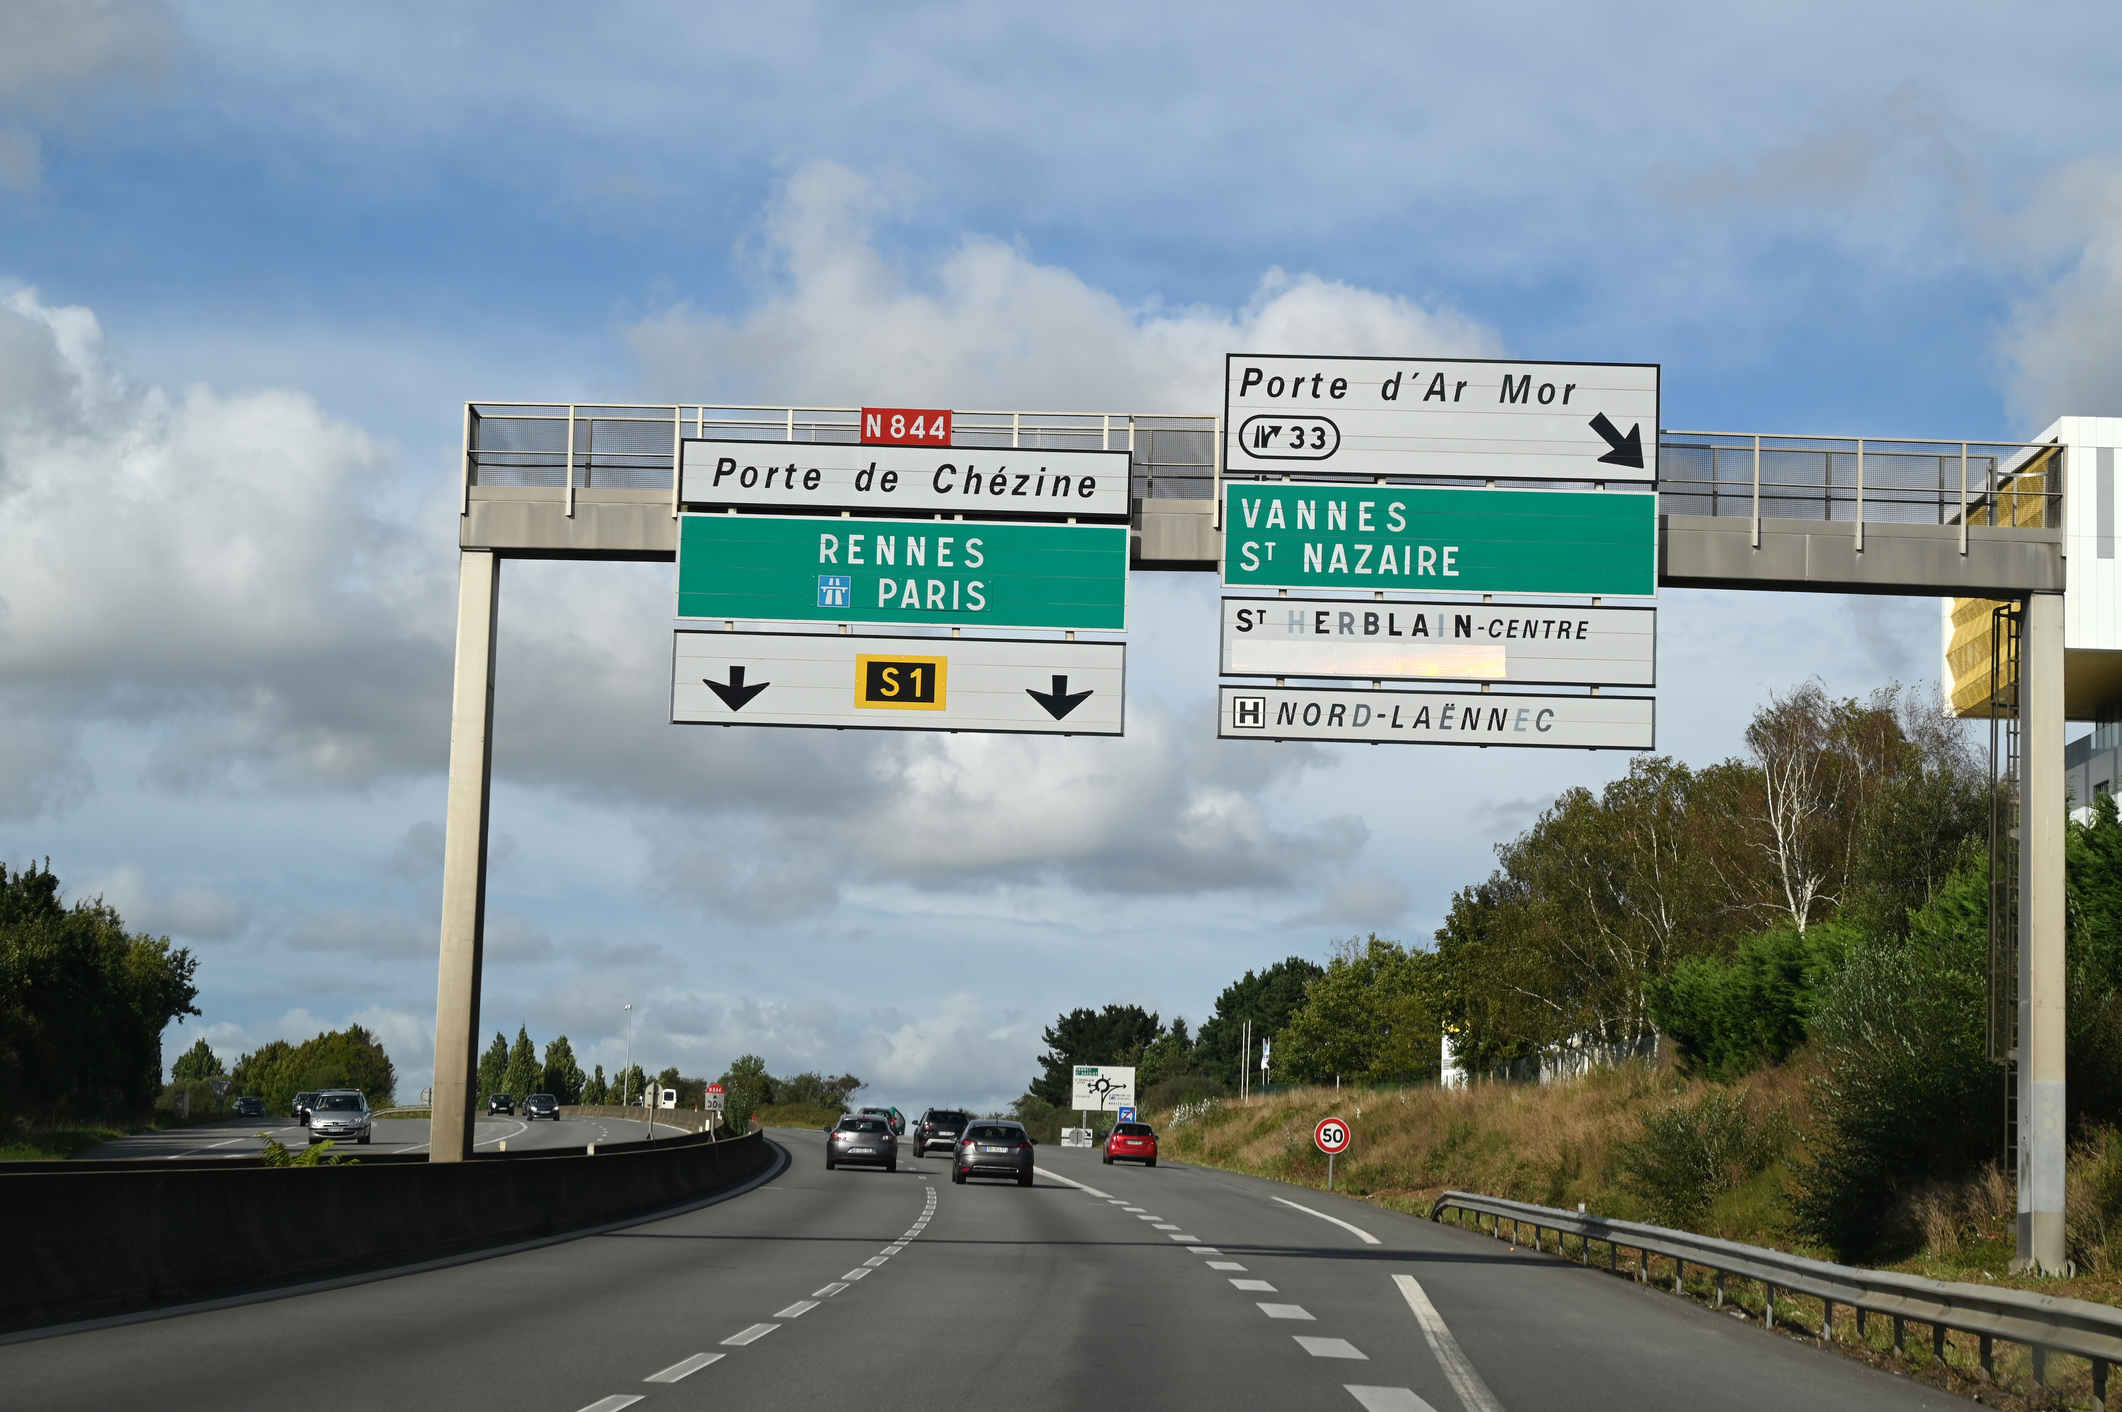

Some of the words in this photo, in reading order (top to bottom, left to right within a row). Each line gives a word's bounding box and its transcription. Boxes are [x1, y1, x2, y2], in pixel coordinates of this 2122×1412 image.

[1240, 367, 1348, 401] Porte
[1381, 371, 1467, 402] d'Ar
[1499, 374, 1576, 405] Mor
[866, 413, 882, 438] N
[889, 414, 946, 440] 844
[1289, 426, 1326, 449] 33
[713, 457, 822, 491] Porte
[855, 462, 898, 493] de
[933, 464, 1096, 498] Chézine
[1241, 498, 1406, 532] VANNES
[819, 534, 984, 568] RENNES
[1303, 543, 1460, 577] NAZAIRE
[878, 578, 986, 611] PARIS
[1277, 701, 1555, 733] NORD-LAËNNEC
[1323, 1128, 1343, 1143] 50
